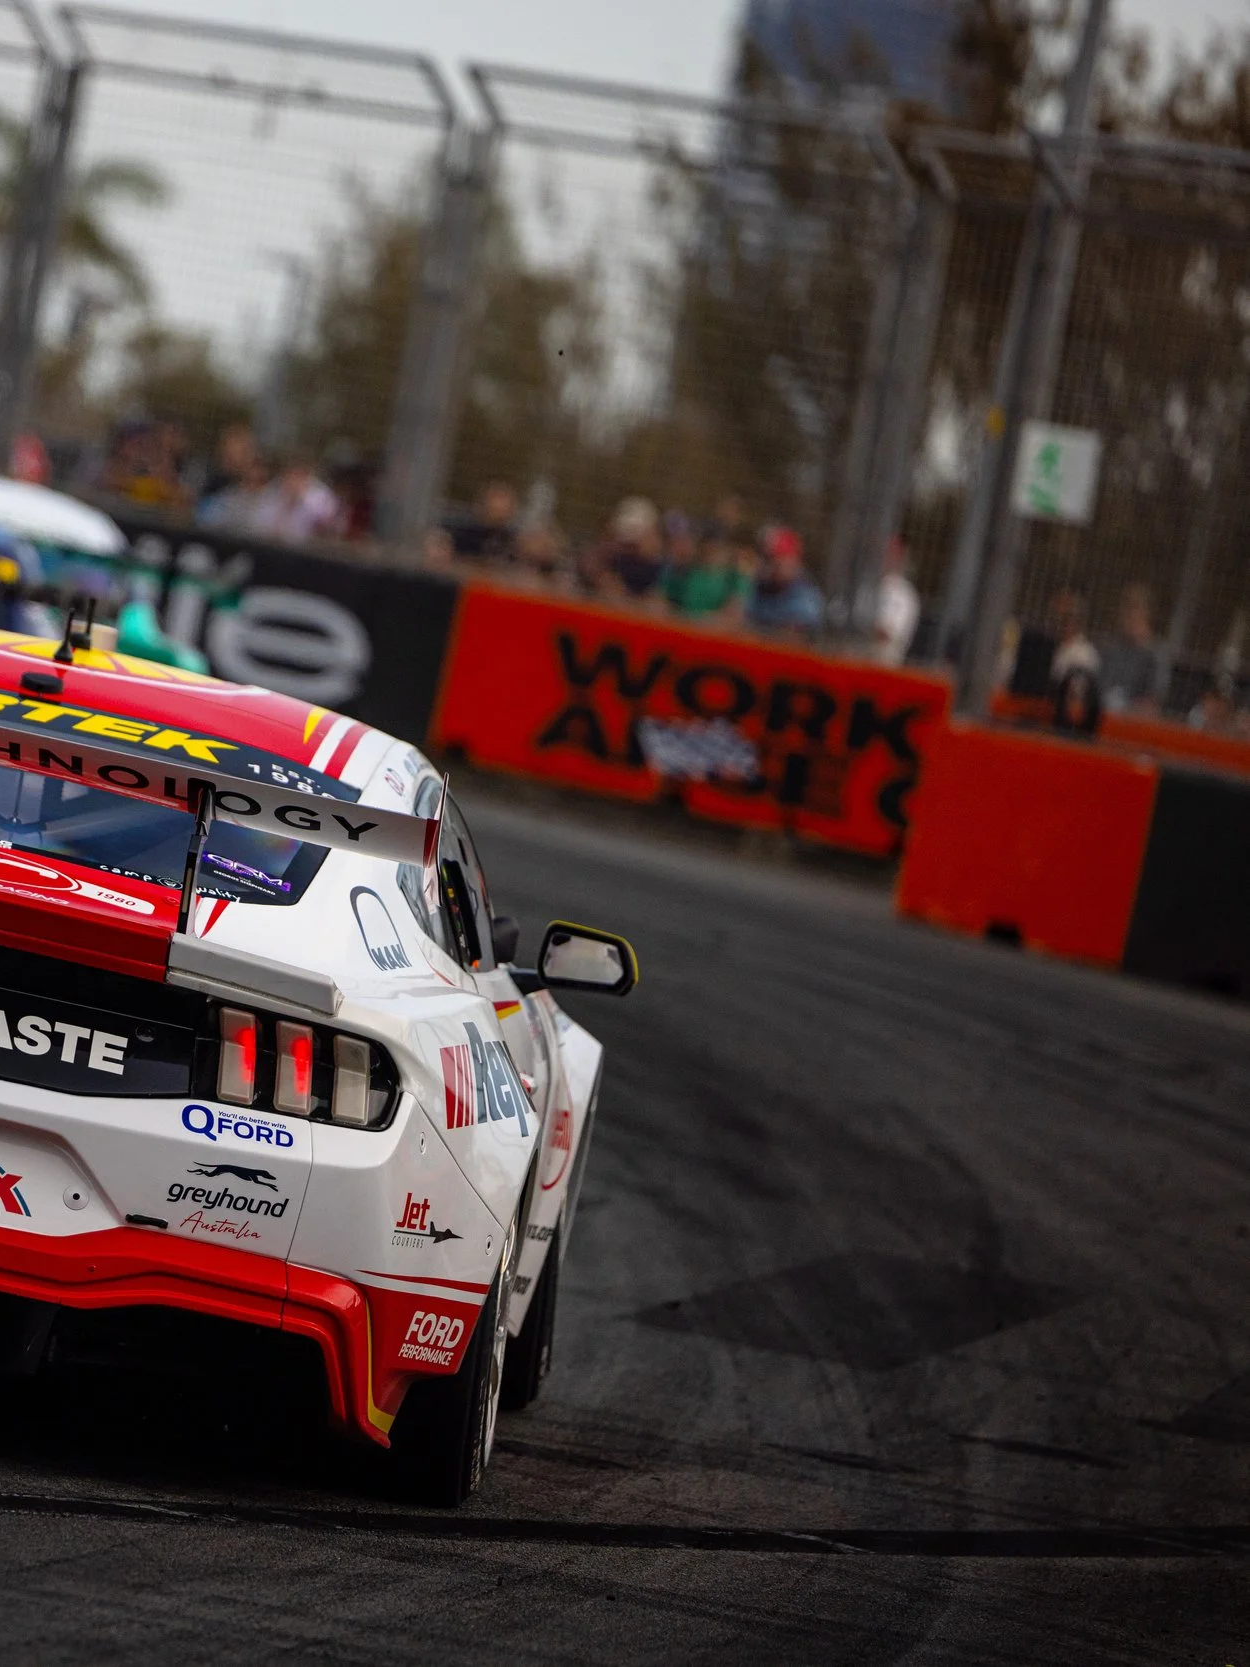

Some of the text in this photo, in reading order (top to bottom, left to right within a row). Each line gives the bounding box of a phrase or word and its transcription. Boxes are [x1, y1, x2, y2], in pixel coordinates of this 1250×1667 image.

[557, 632, 920, 762] WORK
[96, 890, 136, 907] 1980
[99, 865, 241, 903] camp uality
[370, 943, 411, 971] MAN
[248, 1116, 271, 1127] better
[271, 1122, 287, 1130] with
[166, 1183, 290, 1218] greyhound
[396, 1192, 431, 1232] Jet
[180, 1210, 262, 1239] Australia
[391, 1235, 425, 1250] COURIERS
[405, 1310, 465, 1349] FORD
[398, 1343, 454, 1367] PERFORMANCE
